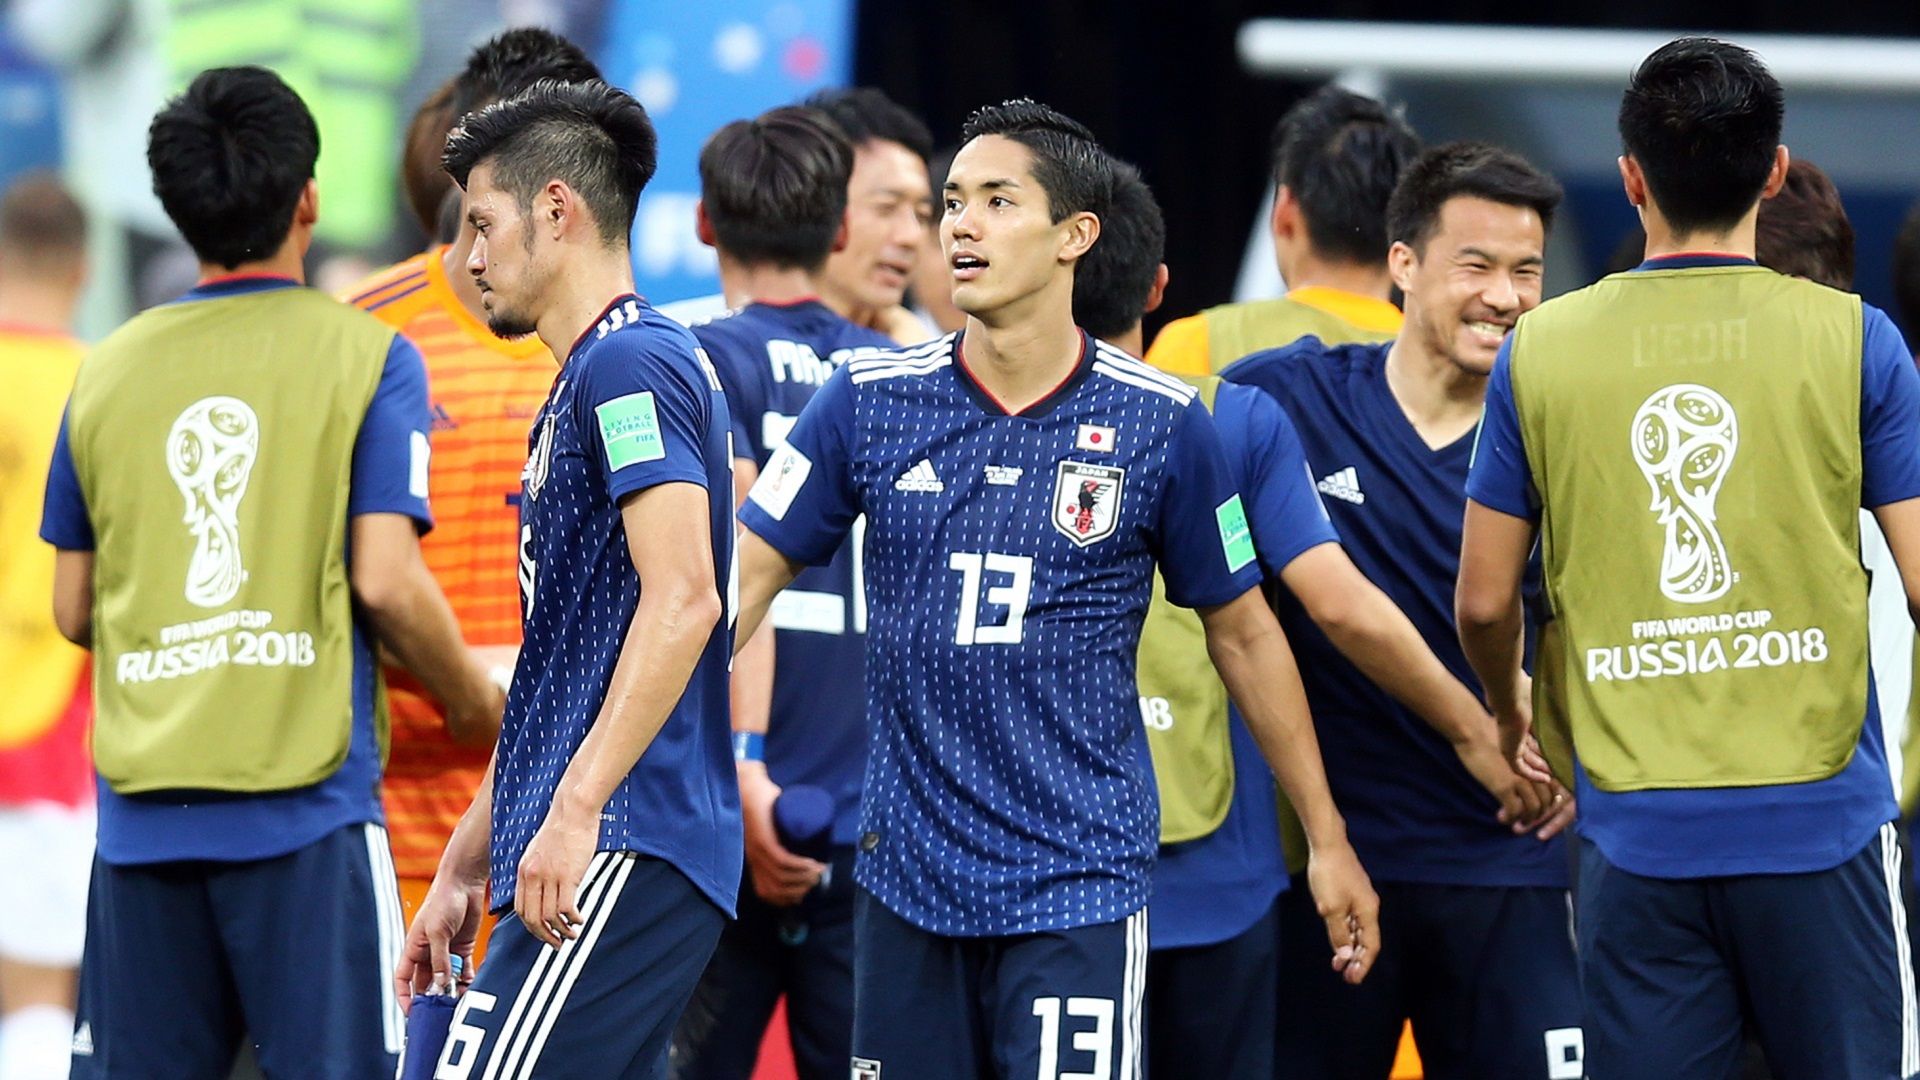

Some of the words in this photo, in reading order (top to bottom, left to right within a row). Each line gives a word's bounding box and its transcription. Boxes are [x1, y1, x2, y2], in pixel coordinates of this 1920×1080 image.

[604, 413, 651, 431] LIVING
[636, 434, 655, 443] FIFA
[1075, 466, 1108, 477] JAPAN
[1317, 480, 1364, 505] adidas
[949, 552, 1033, 646] 13
[239, 610, 273, 628] CUP
[1632, 620, 1667, 639] FIFA
[1667, 613, 1733, 636] WORLD
[1735, 610, 1772, 629] CUP
[116, 635, 230, 684] RUSSIA
[232, 631, 316, 667] 2018
[1587, 637, 1728, 682] RUSSIA
[1733, 628, 1828, 669] 2018
[1032, 997, 1115, 1080] 13
